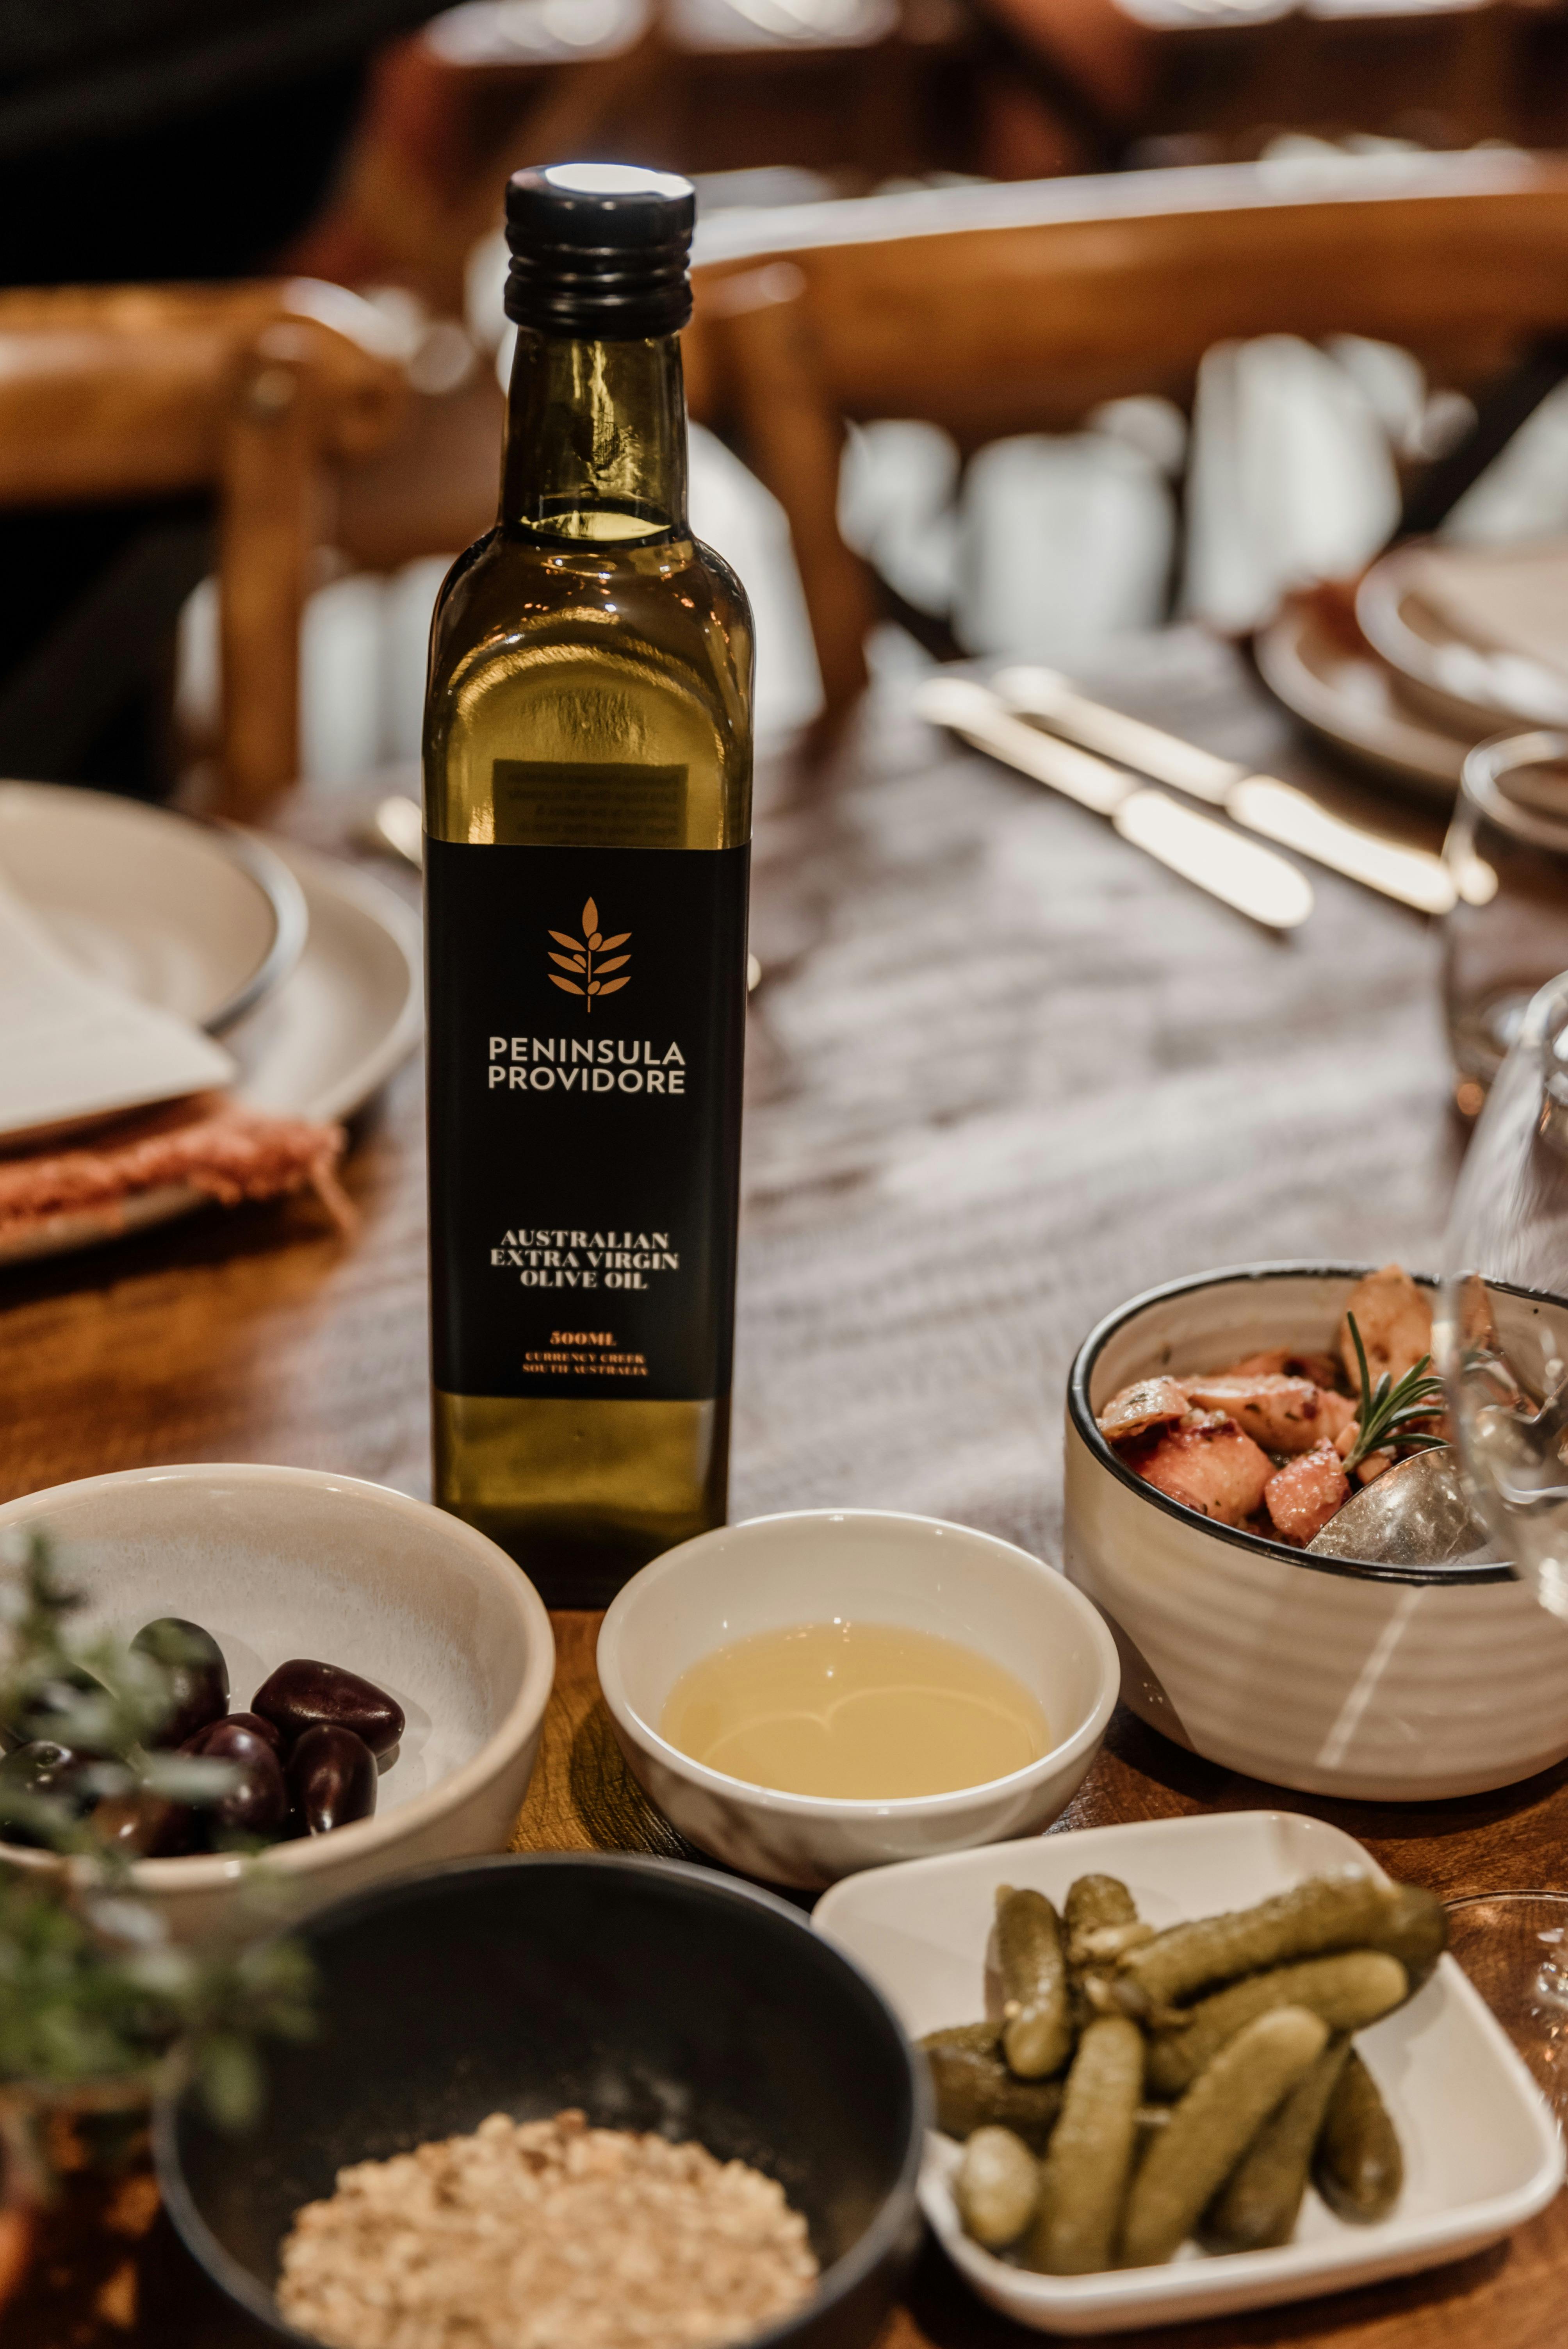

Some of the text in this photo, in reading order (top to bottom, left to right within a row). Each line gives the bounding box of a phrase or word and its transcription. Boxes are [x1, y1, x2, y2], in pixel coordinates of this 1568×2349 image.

[489, 1037, 685, 1065] PENINSULA
[488, 1066, 685, 1093] PROVIDORE
[501, 1230, 669, 1249] AUSTRALIAN
[490, 1249, 679, 1270] EXTRA VIRGIN
[520, 1270, 648, 1289] OLIVE OIL
[549, 1331, 617, 1346] 500ML
[522, 1363, 648, 1376] SOUTH AUSTRALIA
